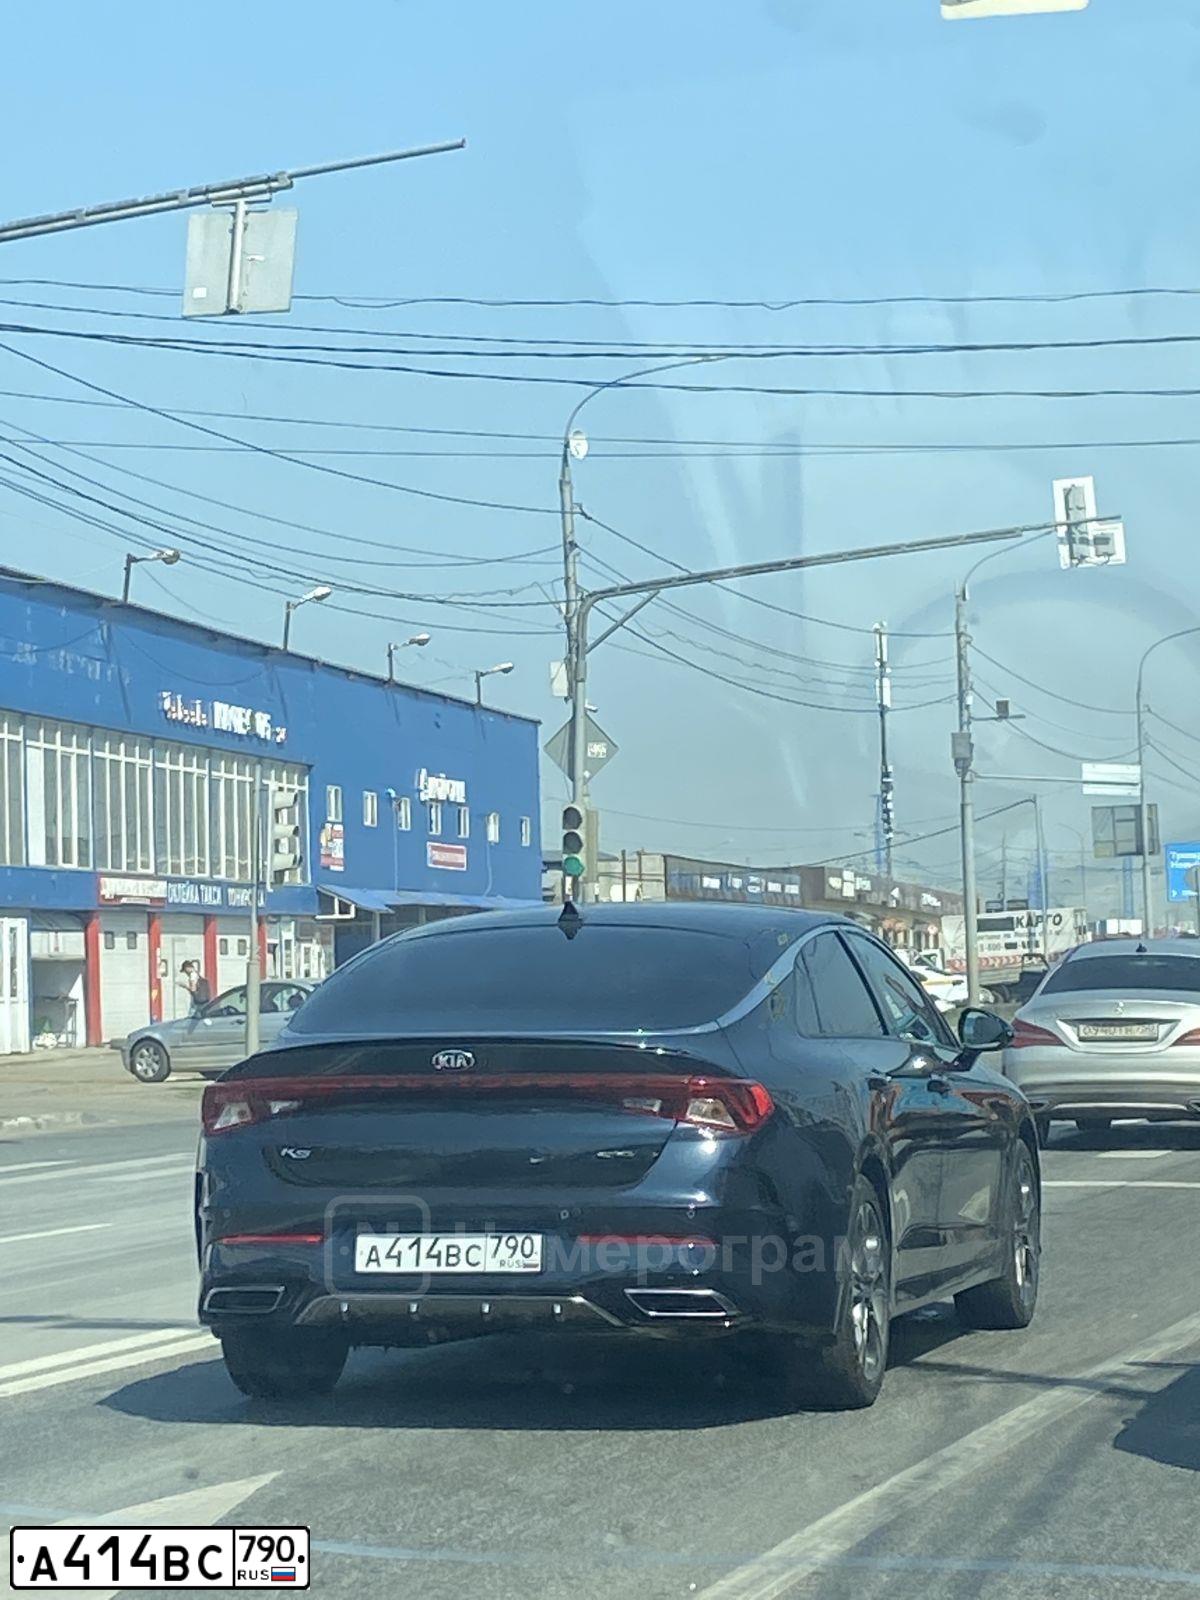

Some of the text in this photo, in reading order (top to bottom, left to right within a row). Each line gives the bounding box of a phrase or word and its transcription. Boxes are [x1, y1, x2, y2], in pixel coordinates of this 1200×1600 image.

[437, 1052, 470, 1068] KIA
[365, 1235, 535, 1268] А414ВС 790
[500, 1260, 522, 1268] RUS
